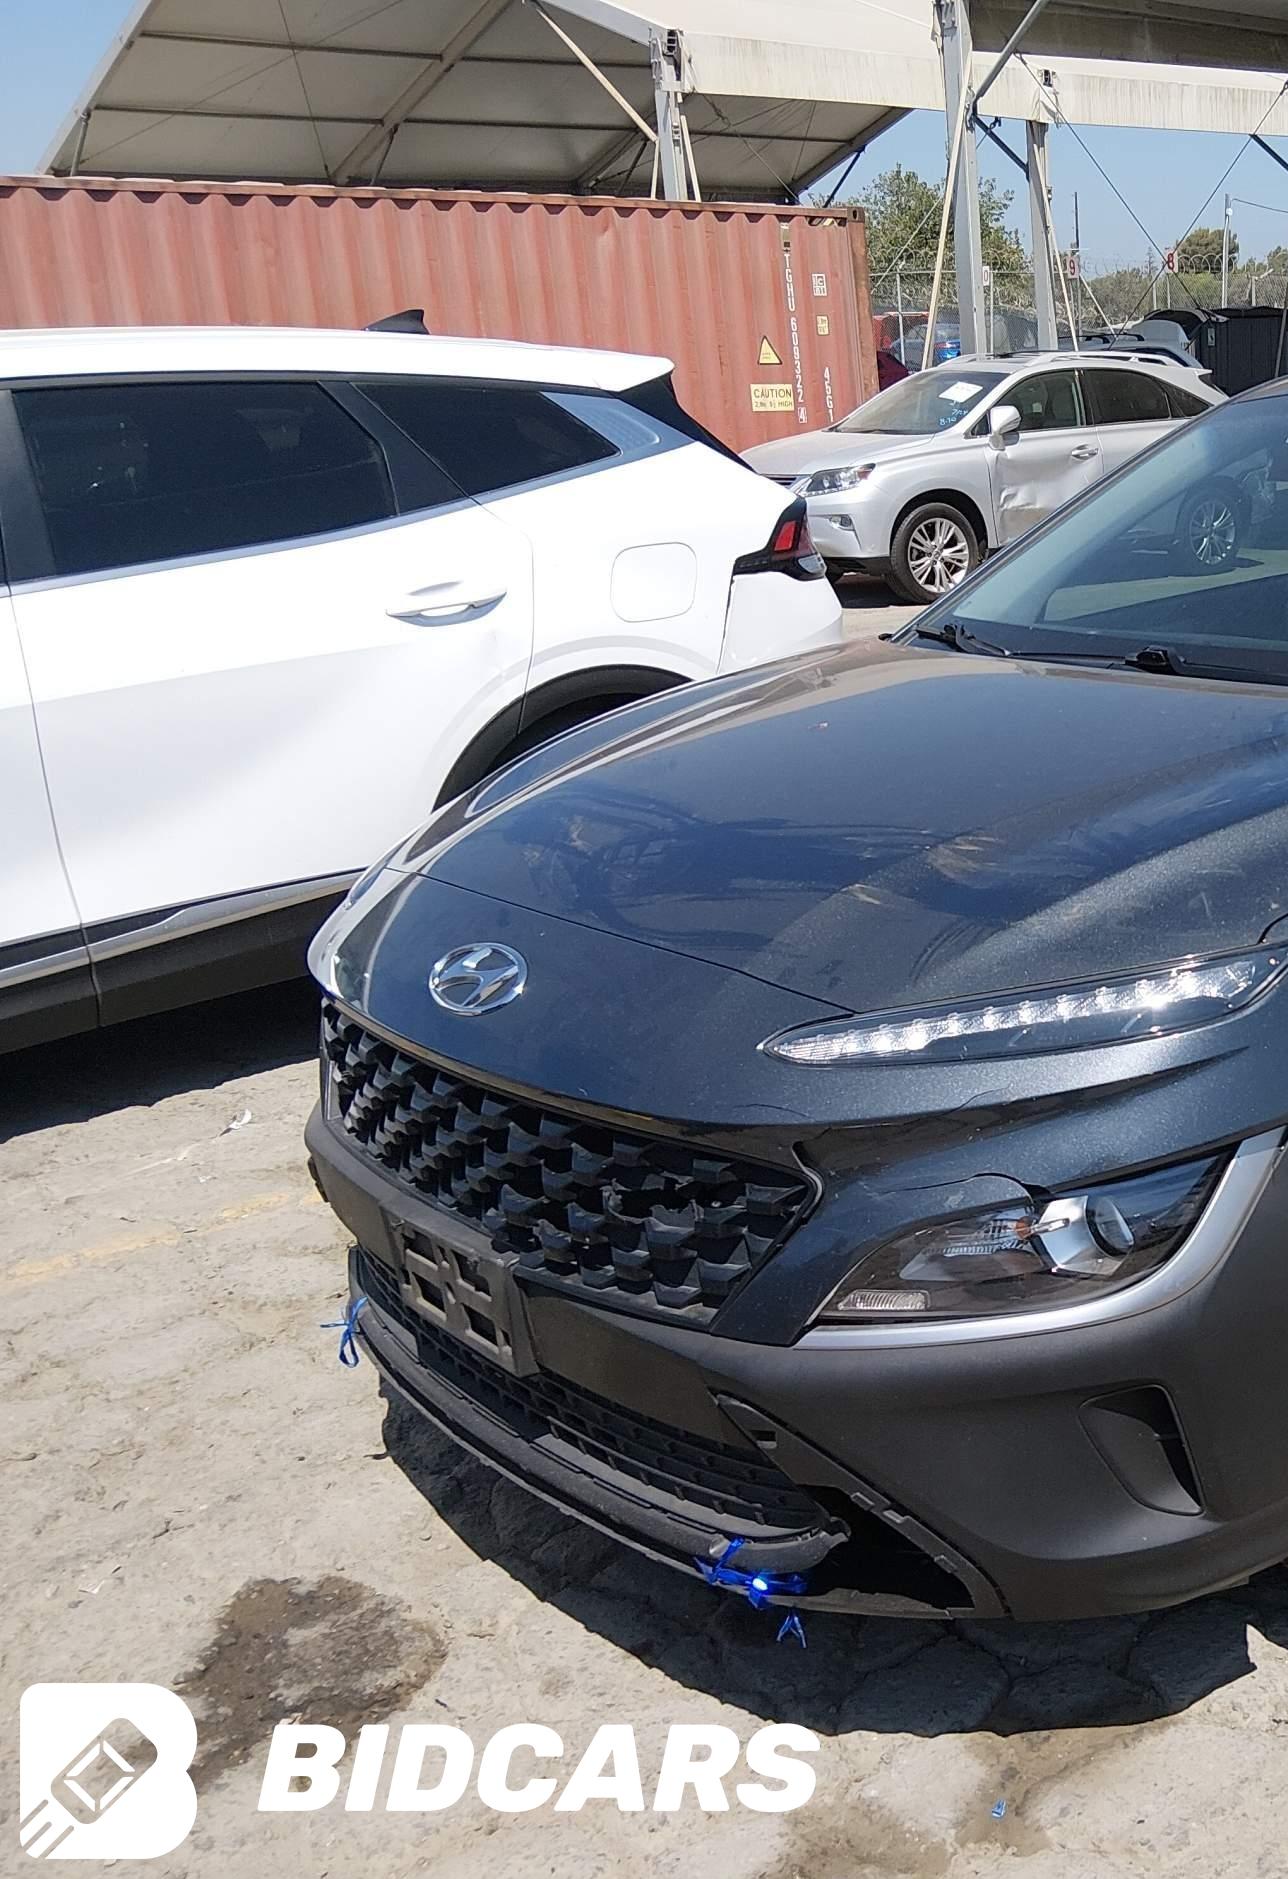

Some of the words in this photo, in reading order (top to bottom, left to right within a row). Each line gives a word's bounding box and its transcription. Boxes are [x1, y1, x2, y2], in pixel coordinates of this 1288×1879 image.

[1069, 259, 1076, 276] 9
[1167, 252, 1175, 270] 8
[784, 253, 796, 312] TGHU
[790, 316, 804, 403] 609322
[753, 388, 792, 399] CAUTION
[824, 366, 834, 423] 45G1
